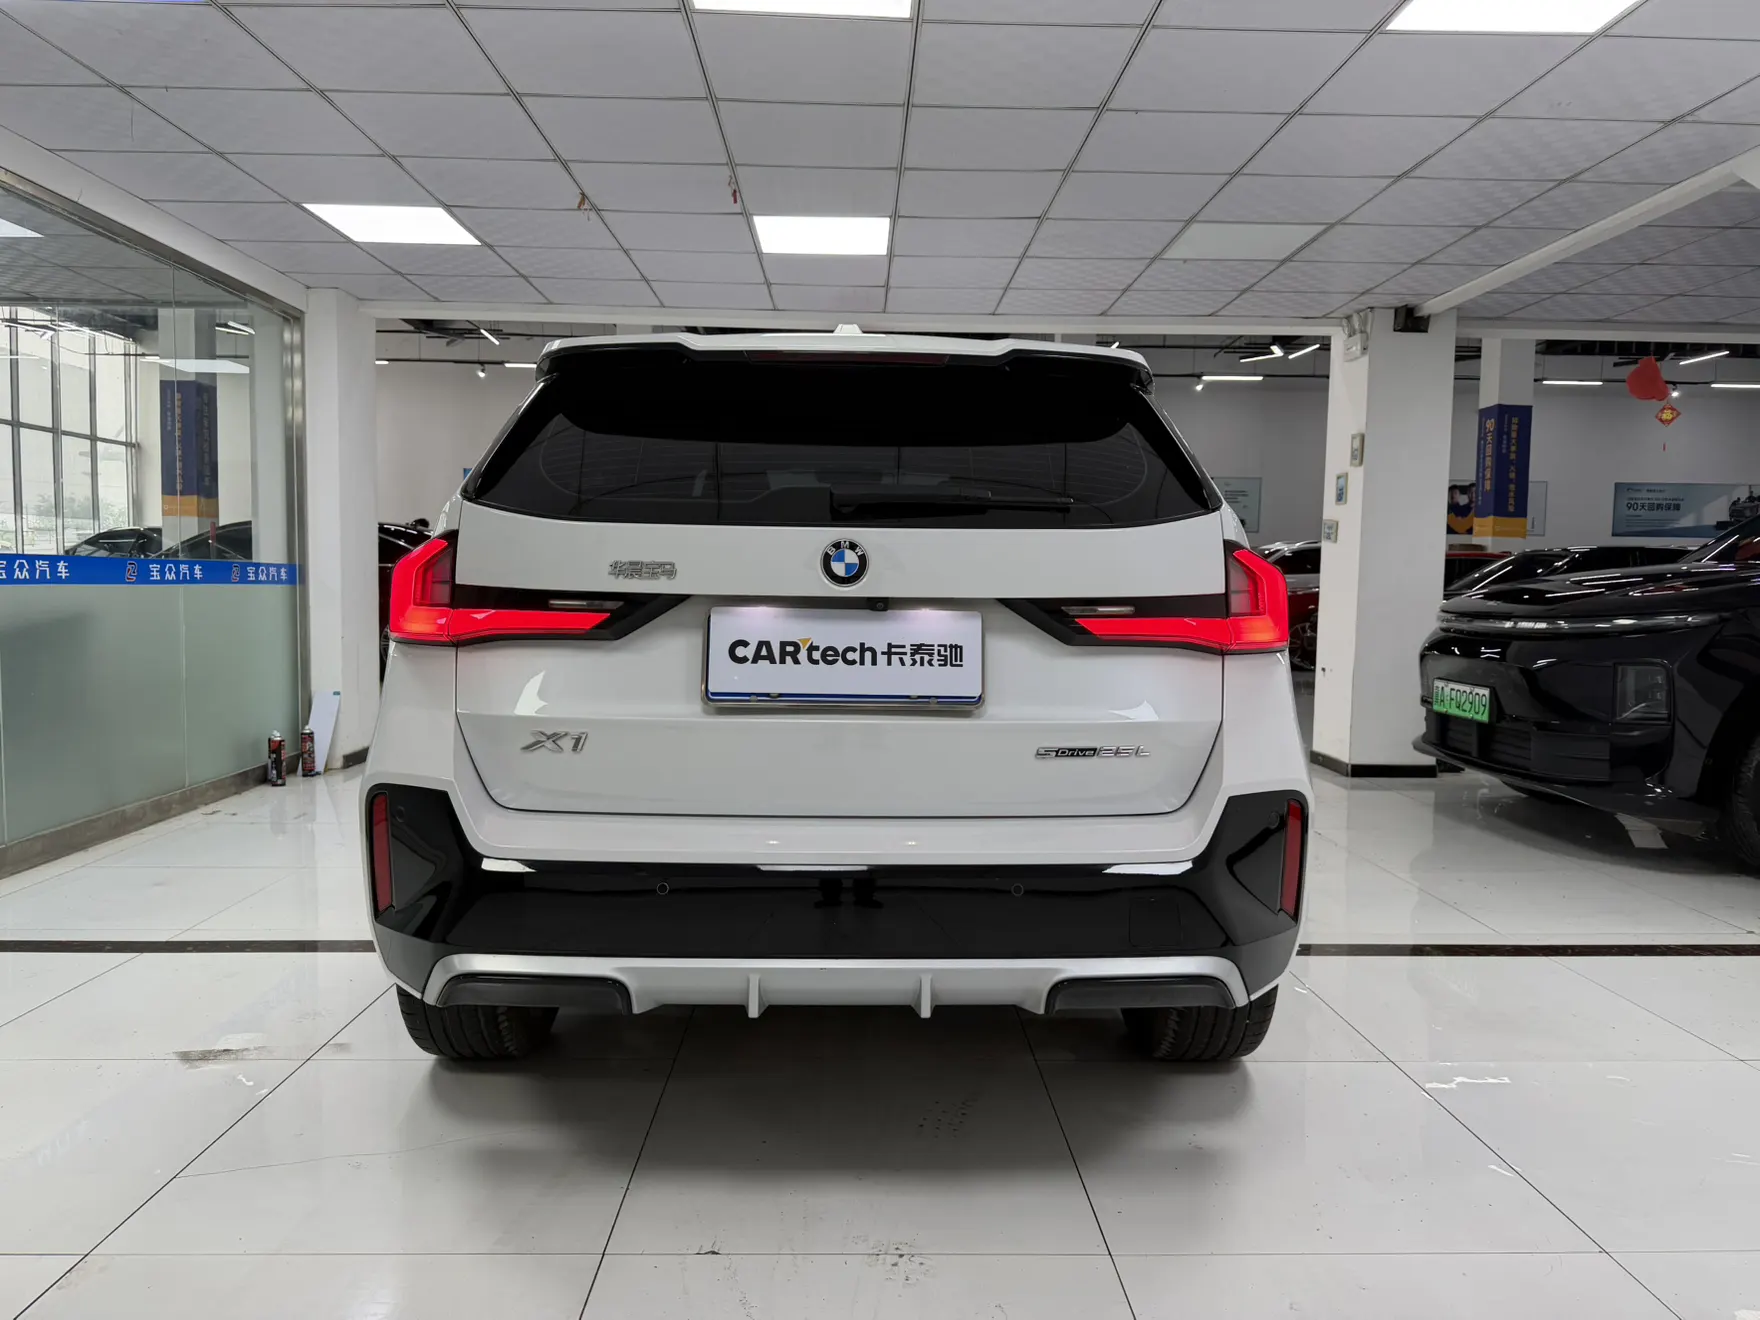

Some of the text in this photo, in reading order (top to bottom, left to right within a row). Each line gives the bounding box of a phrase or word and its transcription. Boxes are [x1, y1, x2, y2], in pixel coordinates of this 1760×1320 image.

[1626, 501, 1681, 512] 90天回购保障
[826, 540, 865, 556] BMW
[149, 563, 203, 581] 宝众汽车
[246, 566, 288, 582] 宝众汽车
[608, 559, 677, 581] 华晨宝马
[728, 637, 964, 668] CARtech 卡泰驰
[520, 729, 589, 753] X1
